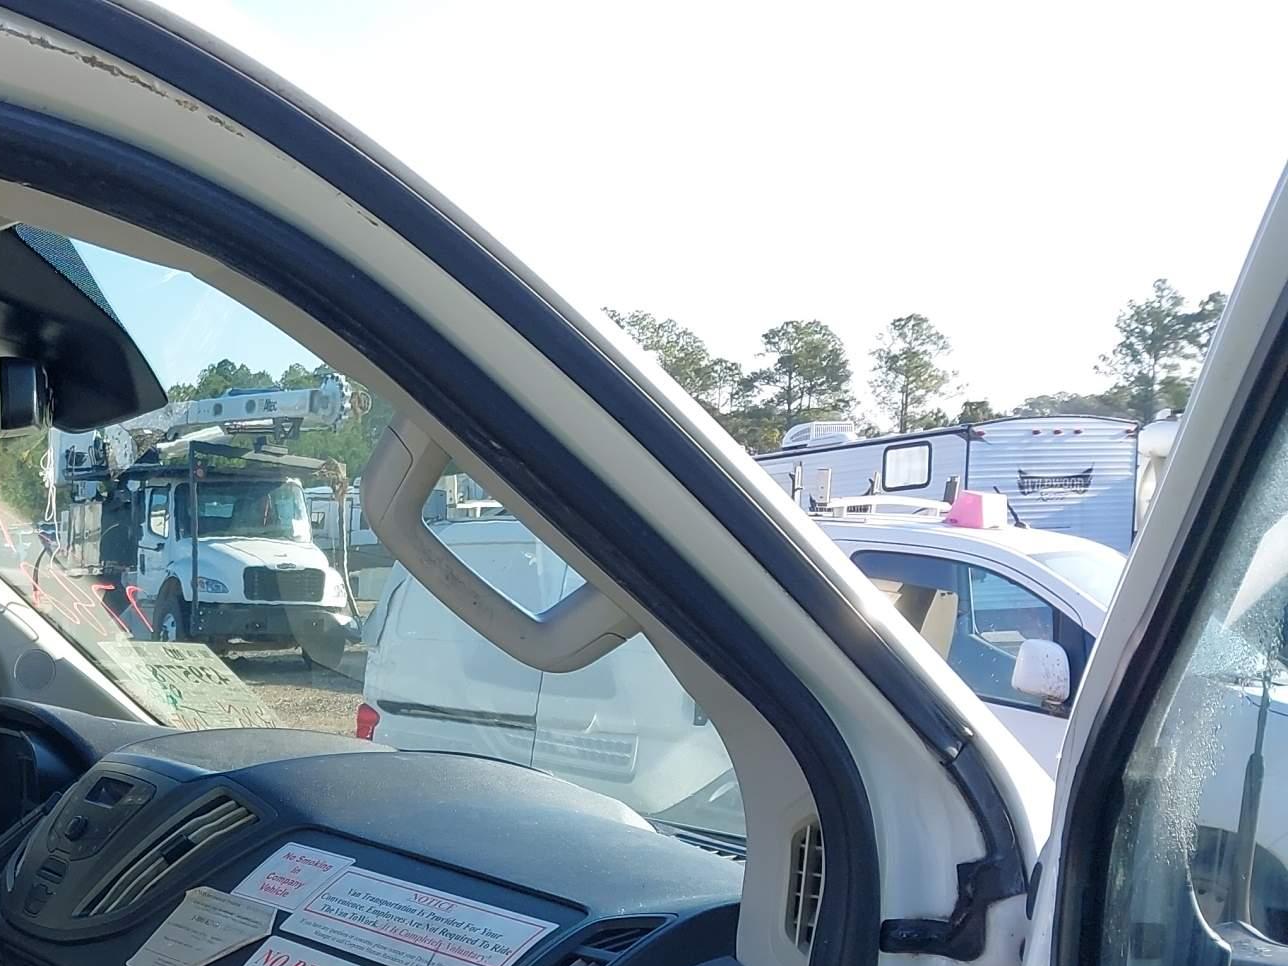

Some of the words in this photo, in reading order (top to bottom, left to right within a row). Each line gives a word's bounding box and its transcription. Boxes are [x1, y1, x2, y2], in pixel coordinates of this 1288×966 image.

[283, 852, 295, 861] No
[297, 856, 334, 872] Smoking
[291, 866, 301, 874] in
[260, 882, 290, 898] Vehicle
[266, 872, 304, 890] Company
[409, 893, 457, 913] NOTICE
[347, 888, 361, 897] Van
[362, 892, 417, 912] Transportation
[426, 912, 464, 928] Provided
[464, 922, 480, 934] For
[480, 928, 504, 940] Your
[320, 904, 334, 914] The
[334, 907, 348, 918] Van
[398, 928, 444, 948] Completely
[366, 906, 406, 924] Employees
[407, 920, 422, 928] Are
[423, 923, 439, 933] Not
[437, 928, 480, 945] Required
[479, 940, 489, 949] To
[491, 944, 512, 956] Ride
